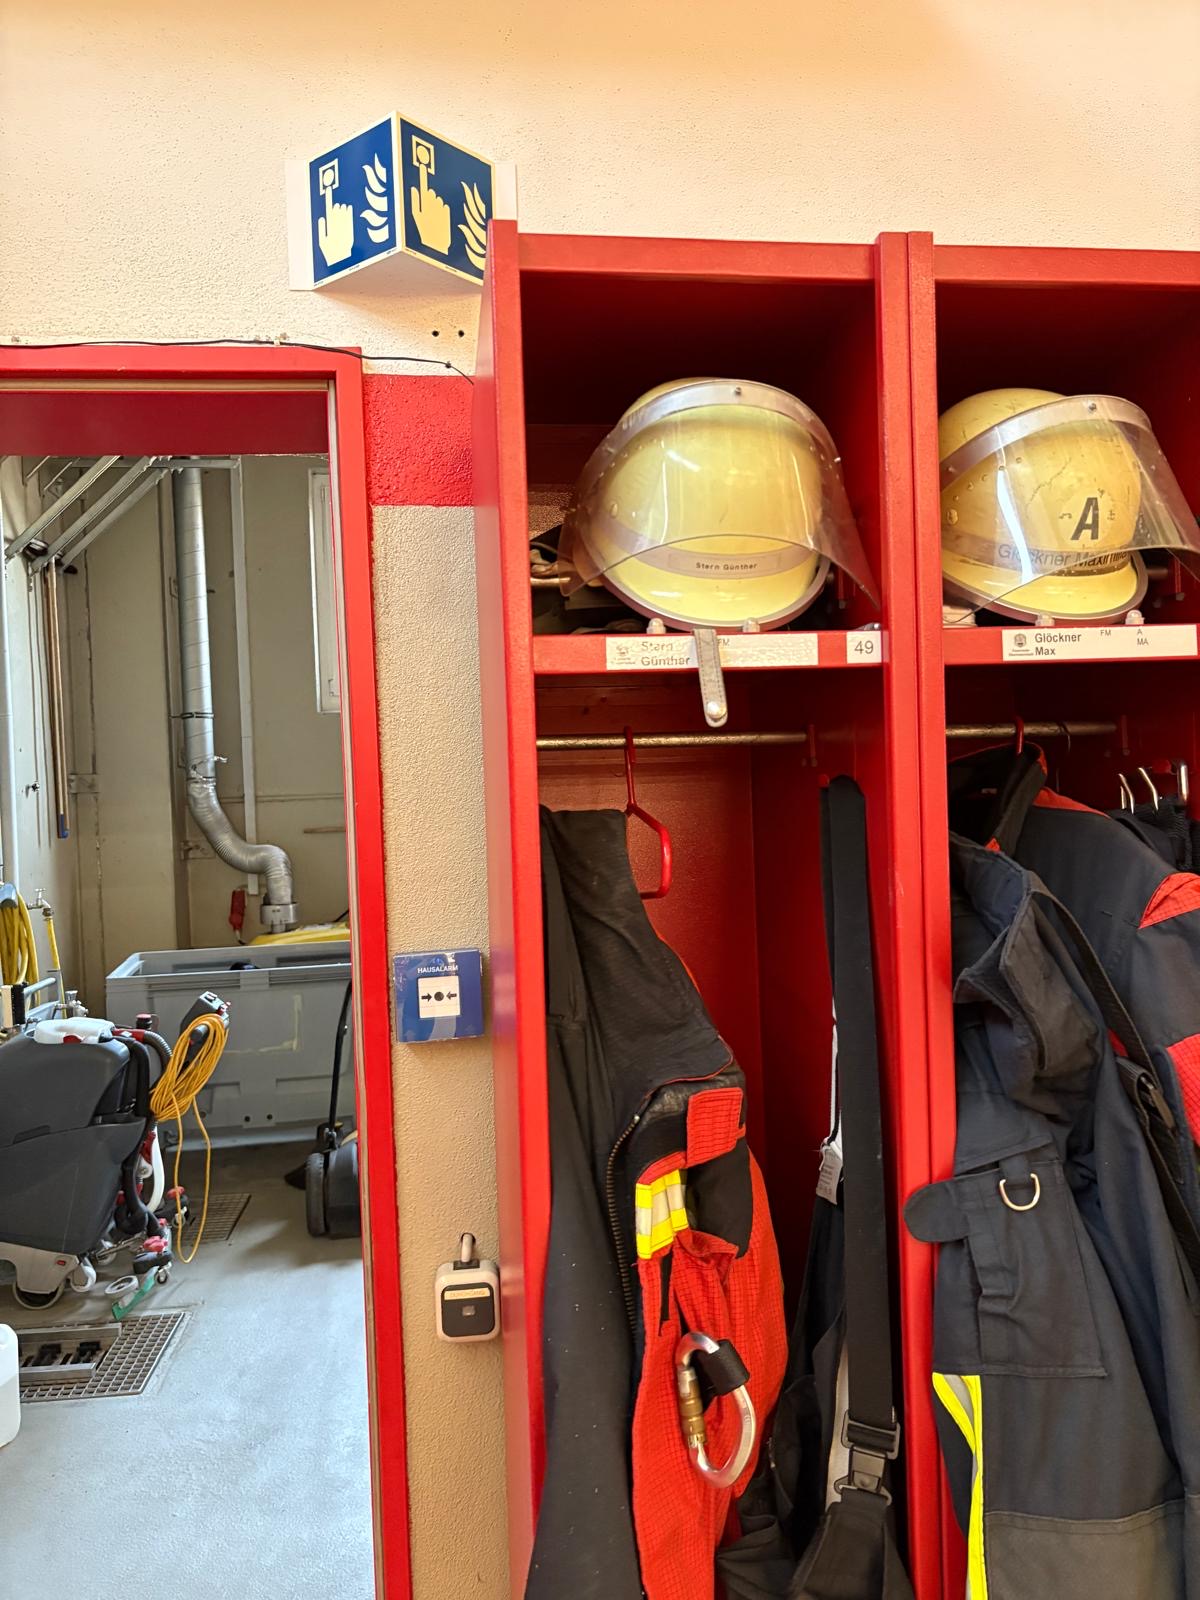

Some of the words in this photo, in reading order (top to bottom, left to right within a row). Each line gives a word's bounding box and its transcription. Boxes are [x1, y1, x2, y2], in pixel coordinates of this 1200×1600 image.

[1070, 497, 1099, 541] A
[695, 562, 720, 570] Stern
[1034, 632, 1082, 644] Glöckner
[1100, 629, 1112, 637] FM
[1137, 638, 1149, 646] MA
[854, 640, 875, 655] 49
[1034, 646, 1056, 656] Max
[640, 656, 691, 667] Günther
[417, 964, 459, 974] HAUSALARM
